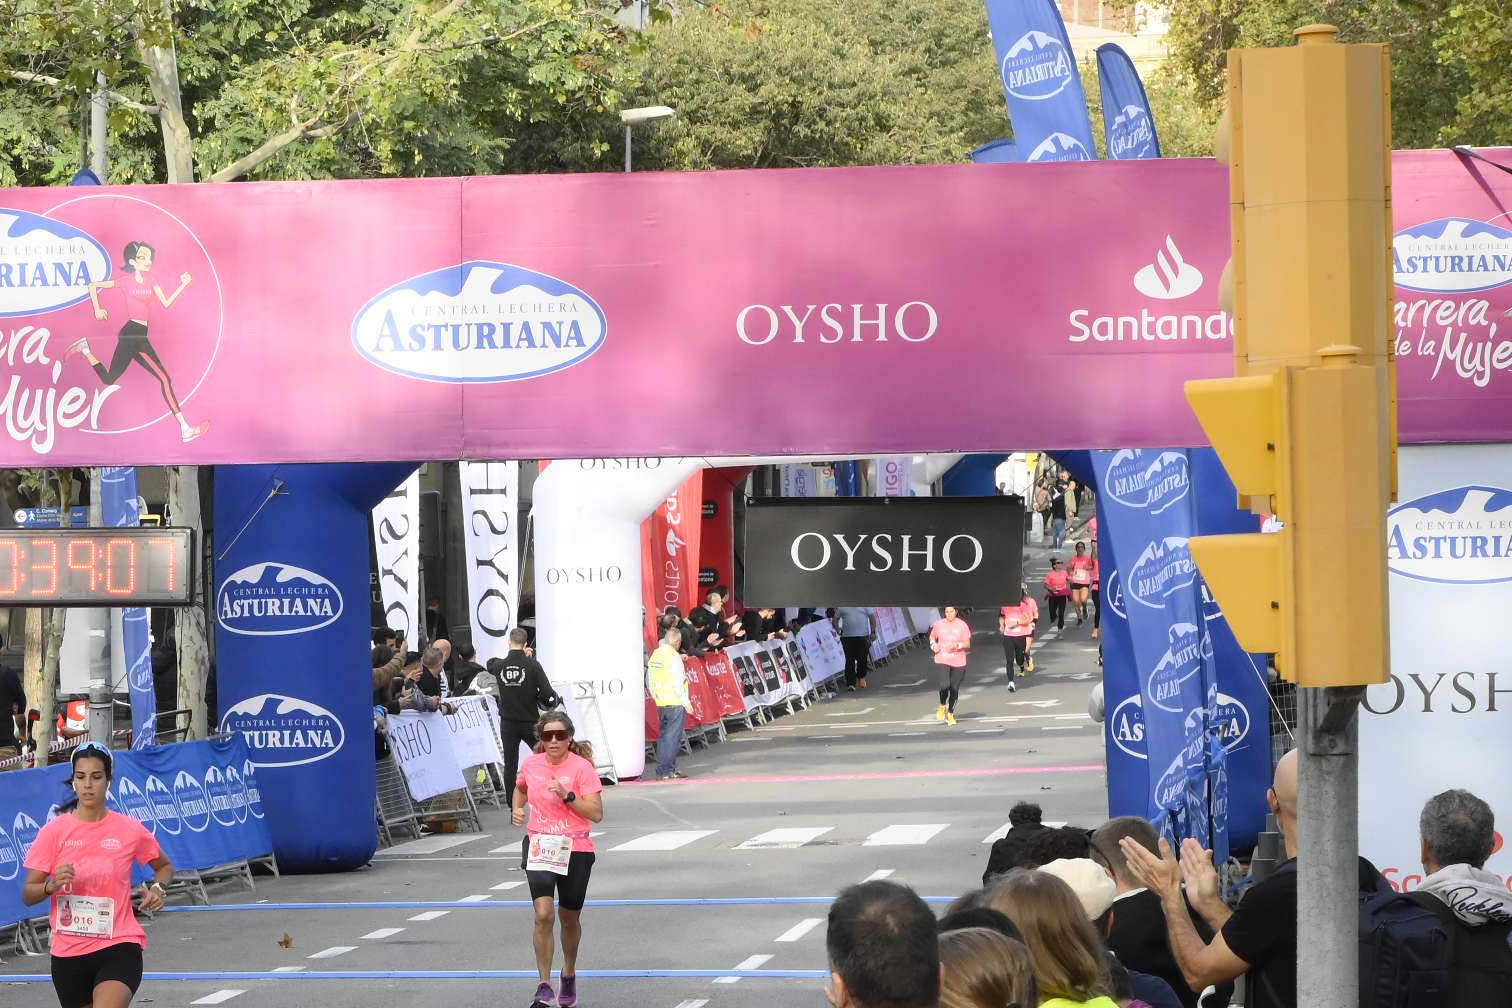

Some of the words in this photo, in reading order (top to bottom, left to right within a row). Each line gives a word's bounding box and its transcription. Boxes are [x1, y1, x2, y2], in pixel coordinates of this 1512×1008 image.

[13, 244, 88, 256] LECHERA
[1465, 240, 1512, 250] LECHER
[409, 304, 489, 316] CENTRAL
[498, 302, 580, 313] LECHERA
[1393, 298, 1490, 328] arrera
[374, 307, 587, 351] ASTURIANA
[735, 301, 939, 345] OYSHO
[1069, 308, 1235, 342] Santand
[1418, 327, 1436, 355] la
[1414, 520, 1482, 530] CENTRAL
[791, 532, 984, 573] OYSHO
[546, 566, 622, 585] OYSHO
[233, 588, 277, 597] CENTRAL
[281, 588, 330, 596] LECHERA
[221, 592, 334, 620] ASTURIANA
[235, 720, 276, 728] CENTRAL
[281, 719, 330, 727] LECHERA
[243, 729, 335, 748] TURIANA
[393, 719, 432, 764] SHO
